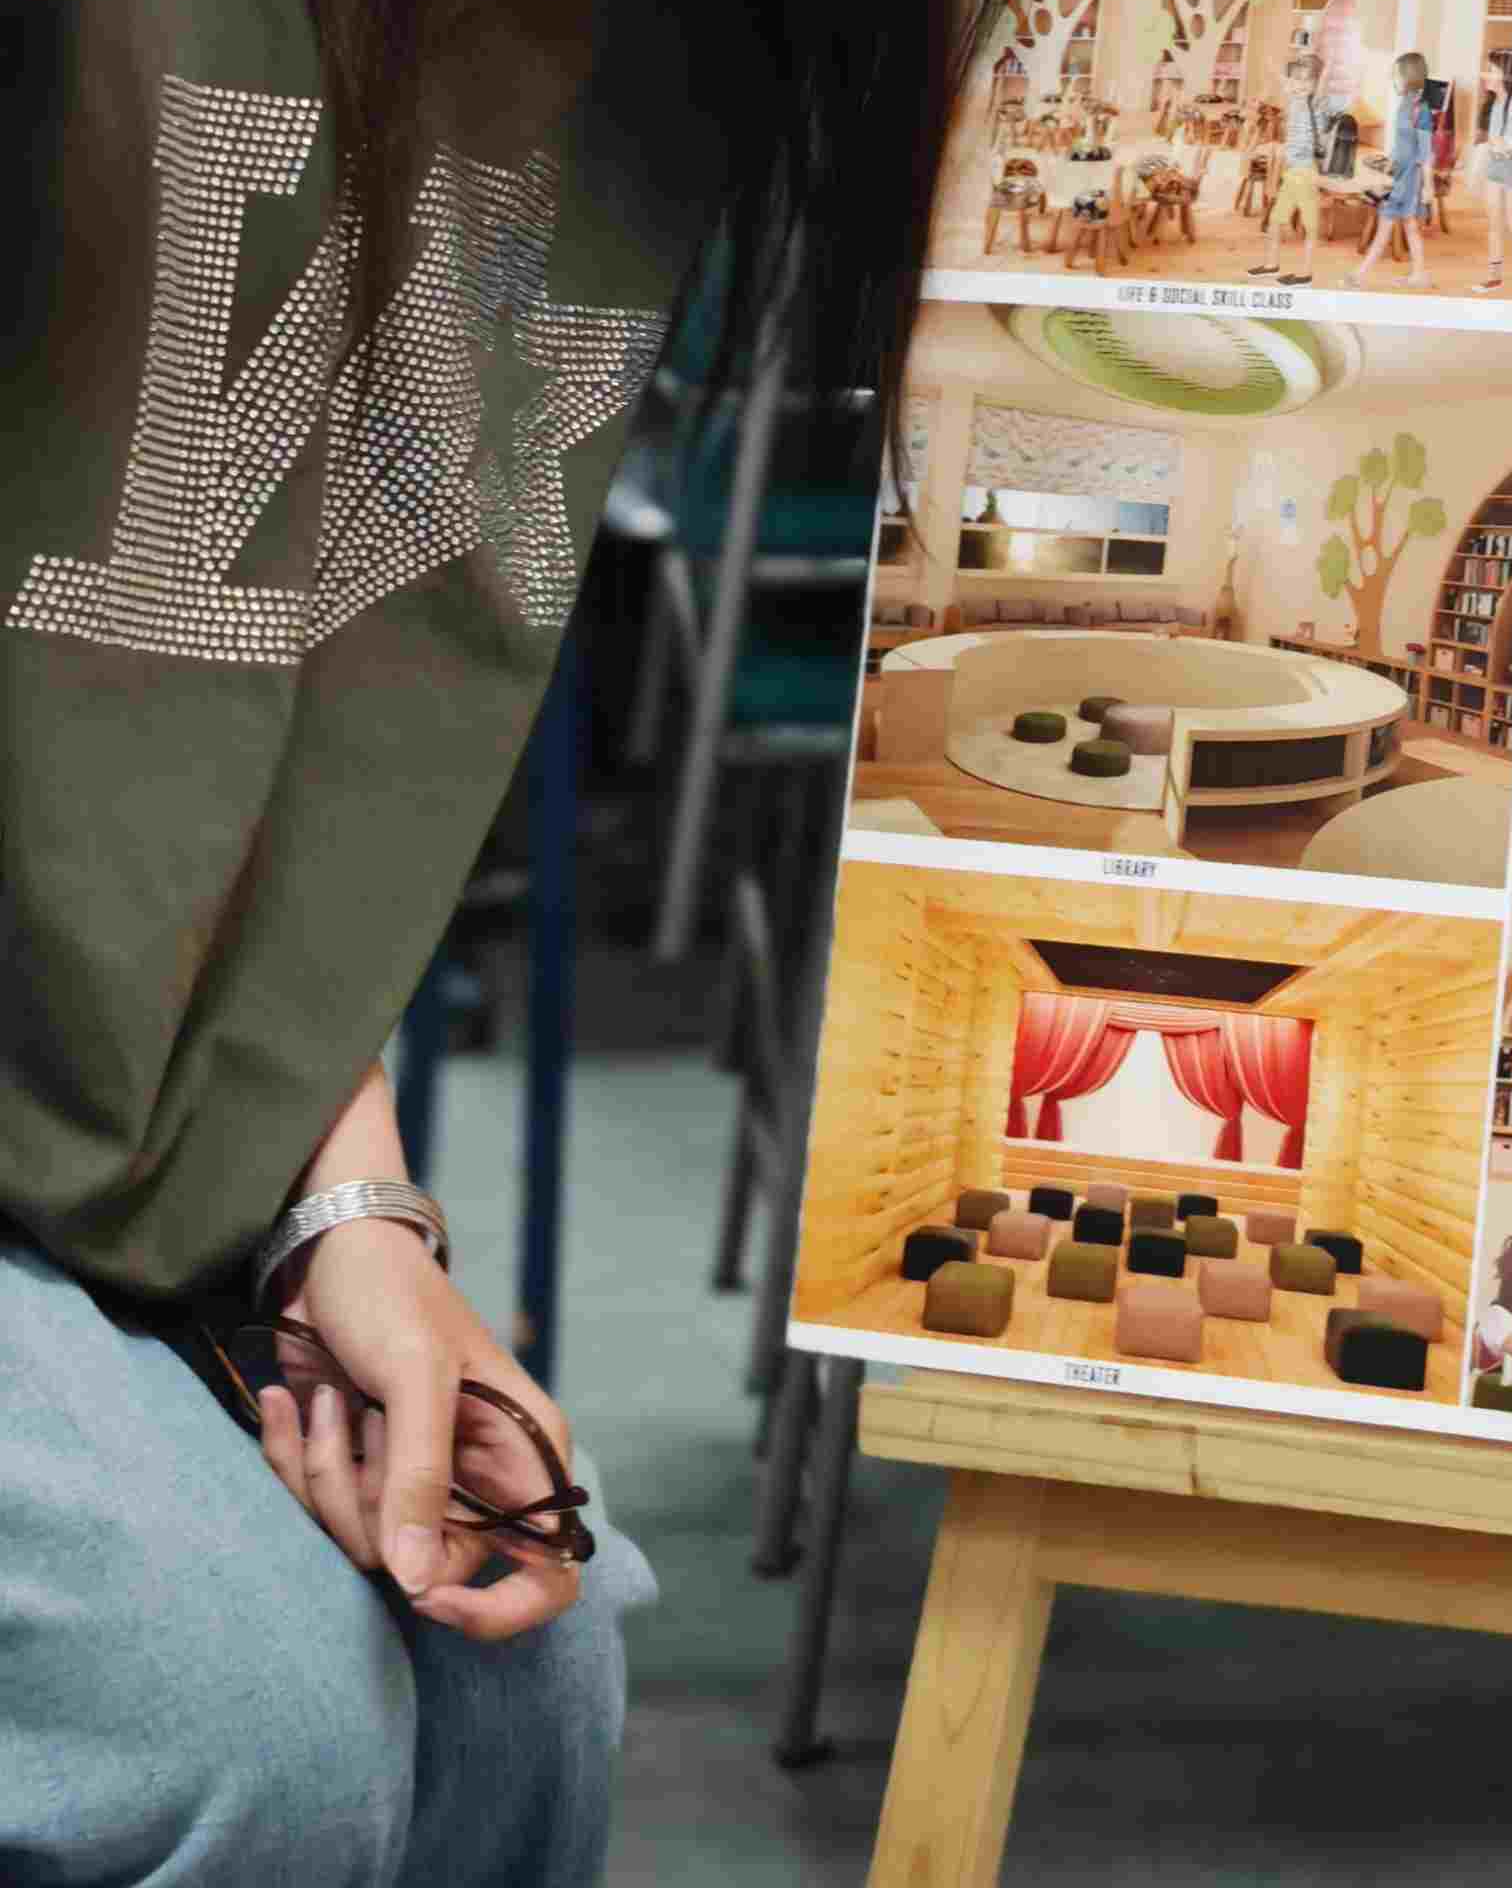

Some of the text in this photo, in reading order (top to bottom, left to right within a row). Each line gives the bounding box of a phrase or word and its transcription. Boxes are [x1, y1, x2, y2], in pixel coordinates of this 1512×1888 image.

[1118, 286, 1143, 302] LIFE
[1162, 287, 1207, 304] SOCIAL
[1212, 290, 1246, 308] SKILL
[1251, 291, 1294, 310] CLASS
[1103, 858, 1157, 877] LIBRARY
